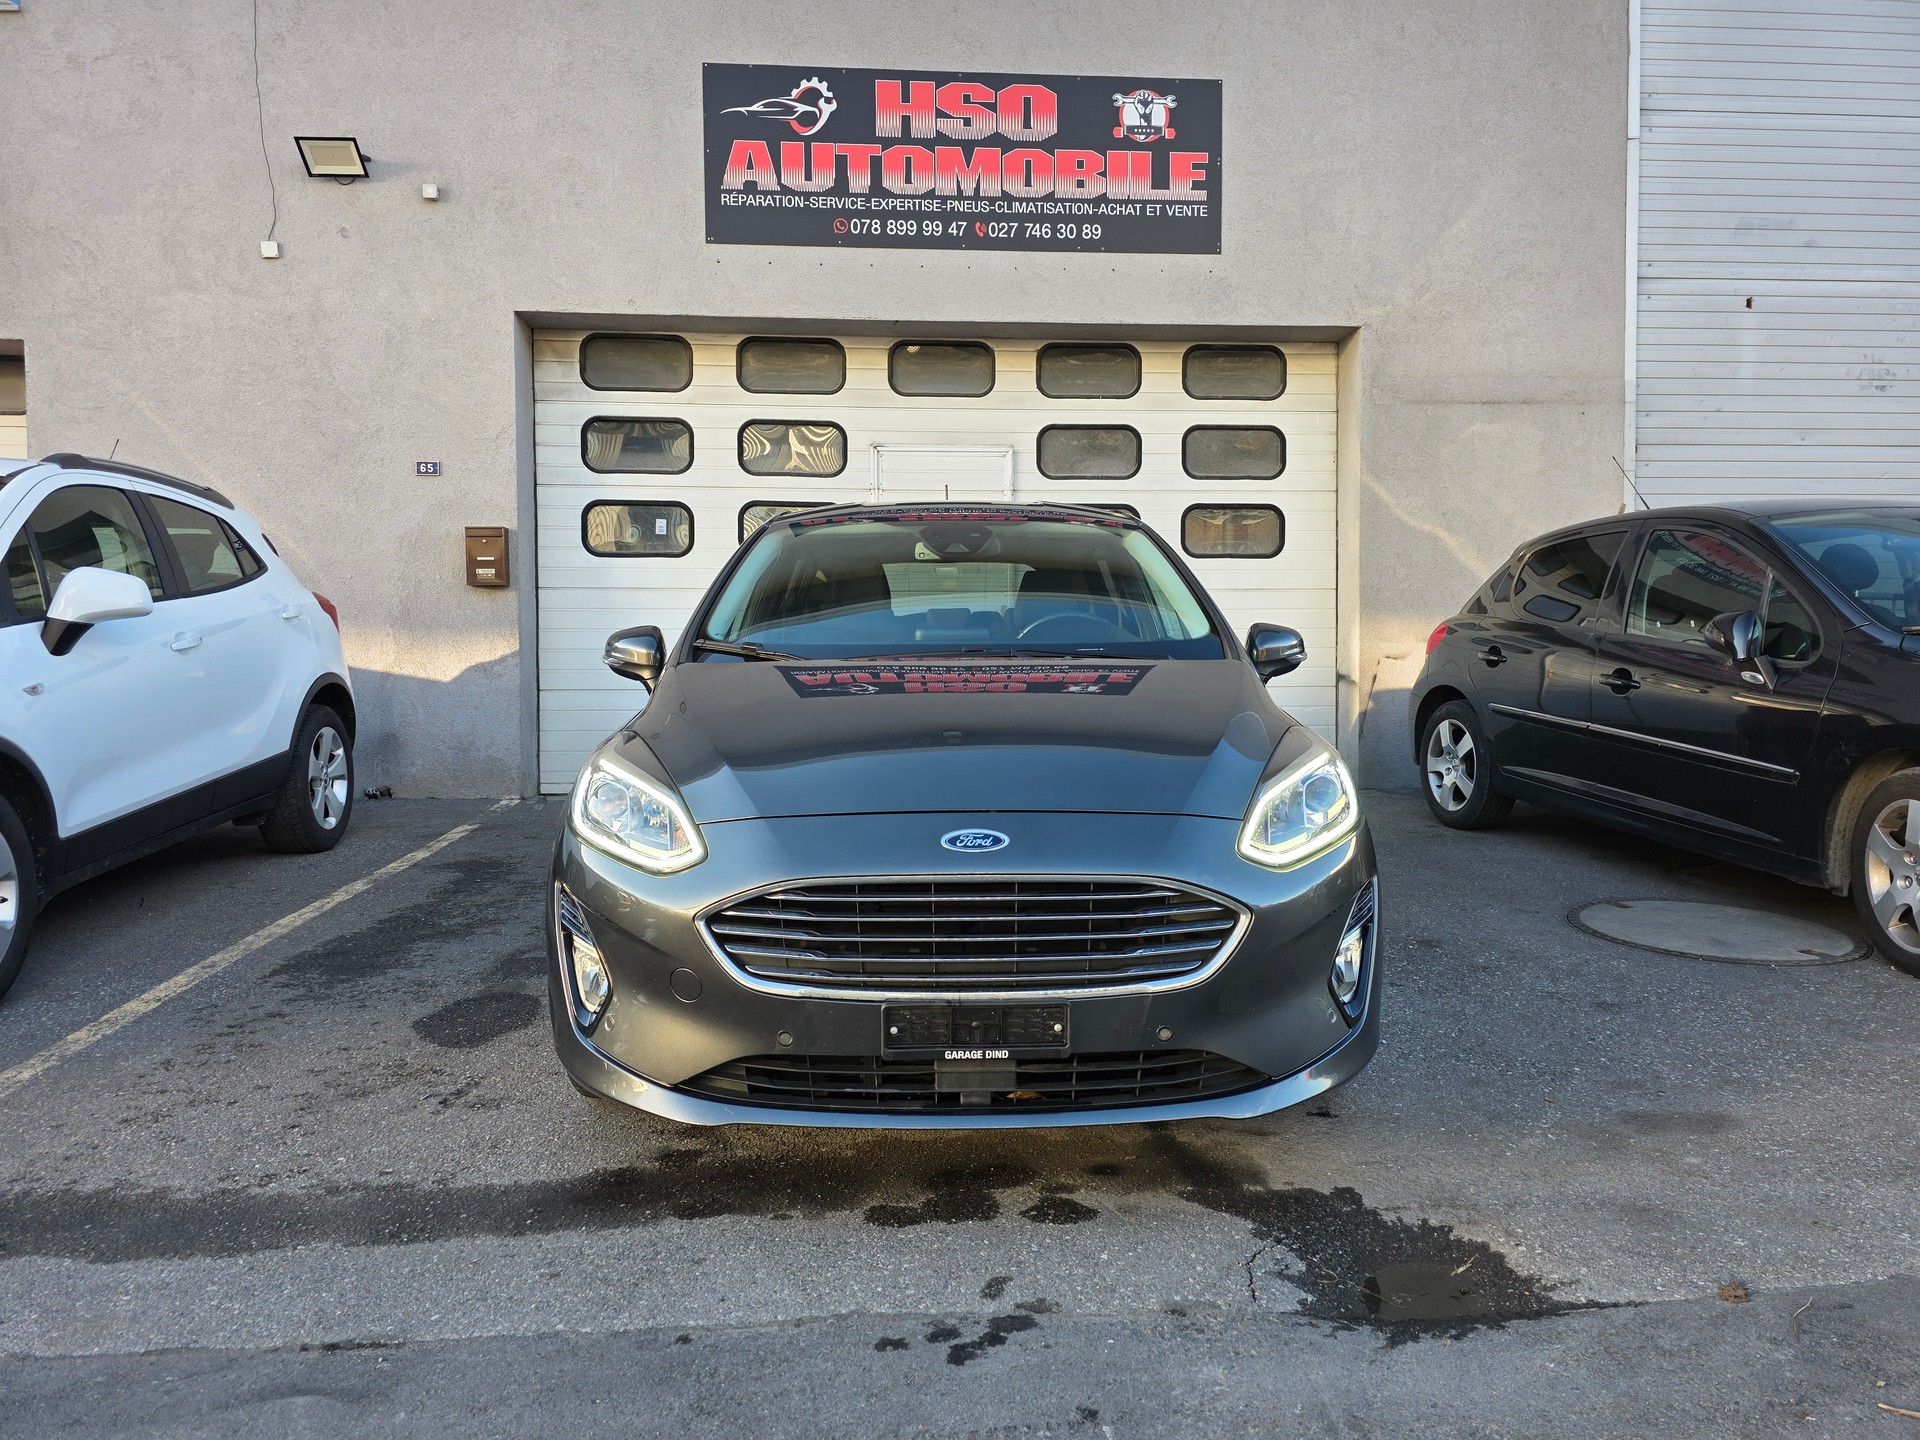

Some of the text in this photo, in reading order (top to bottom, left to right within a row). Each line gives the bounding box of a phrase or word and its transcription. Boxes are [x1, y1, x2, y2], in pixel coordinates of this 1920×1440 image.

[875, 79, 1058, 142] HSO
[721, 139, 1209, 201] AUTOMOBILE
[1146, 204, 1163, 216] ET
[1166, 204, 1208, 217] VENTE
[850, 218, 968, 237] 078 899 99 47
[988, 222, 1102, 239] 027 746 30 89
[420, 463, 434, 473] 65
[956, 832, 993, 847] Ford
[944, 1050, 1009, 1060] GARAGE DIND
